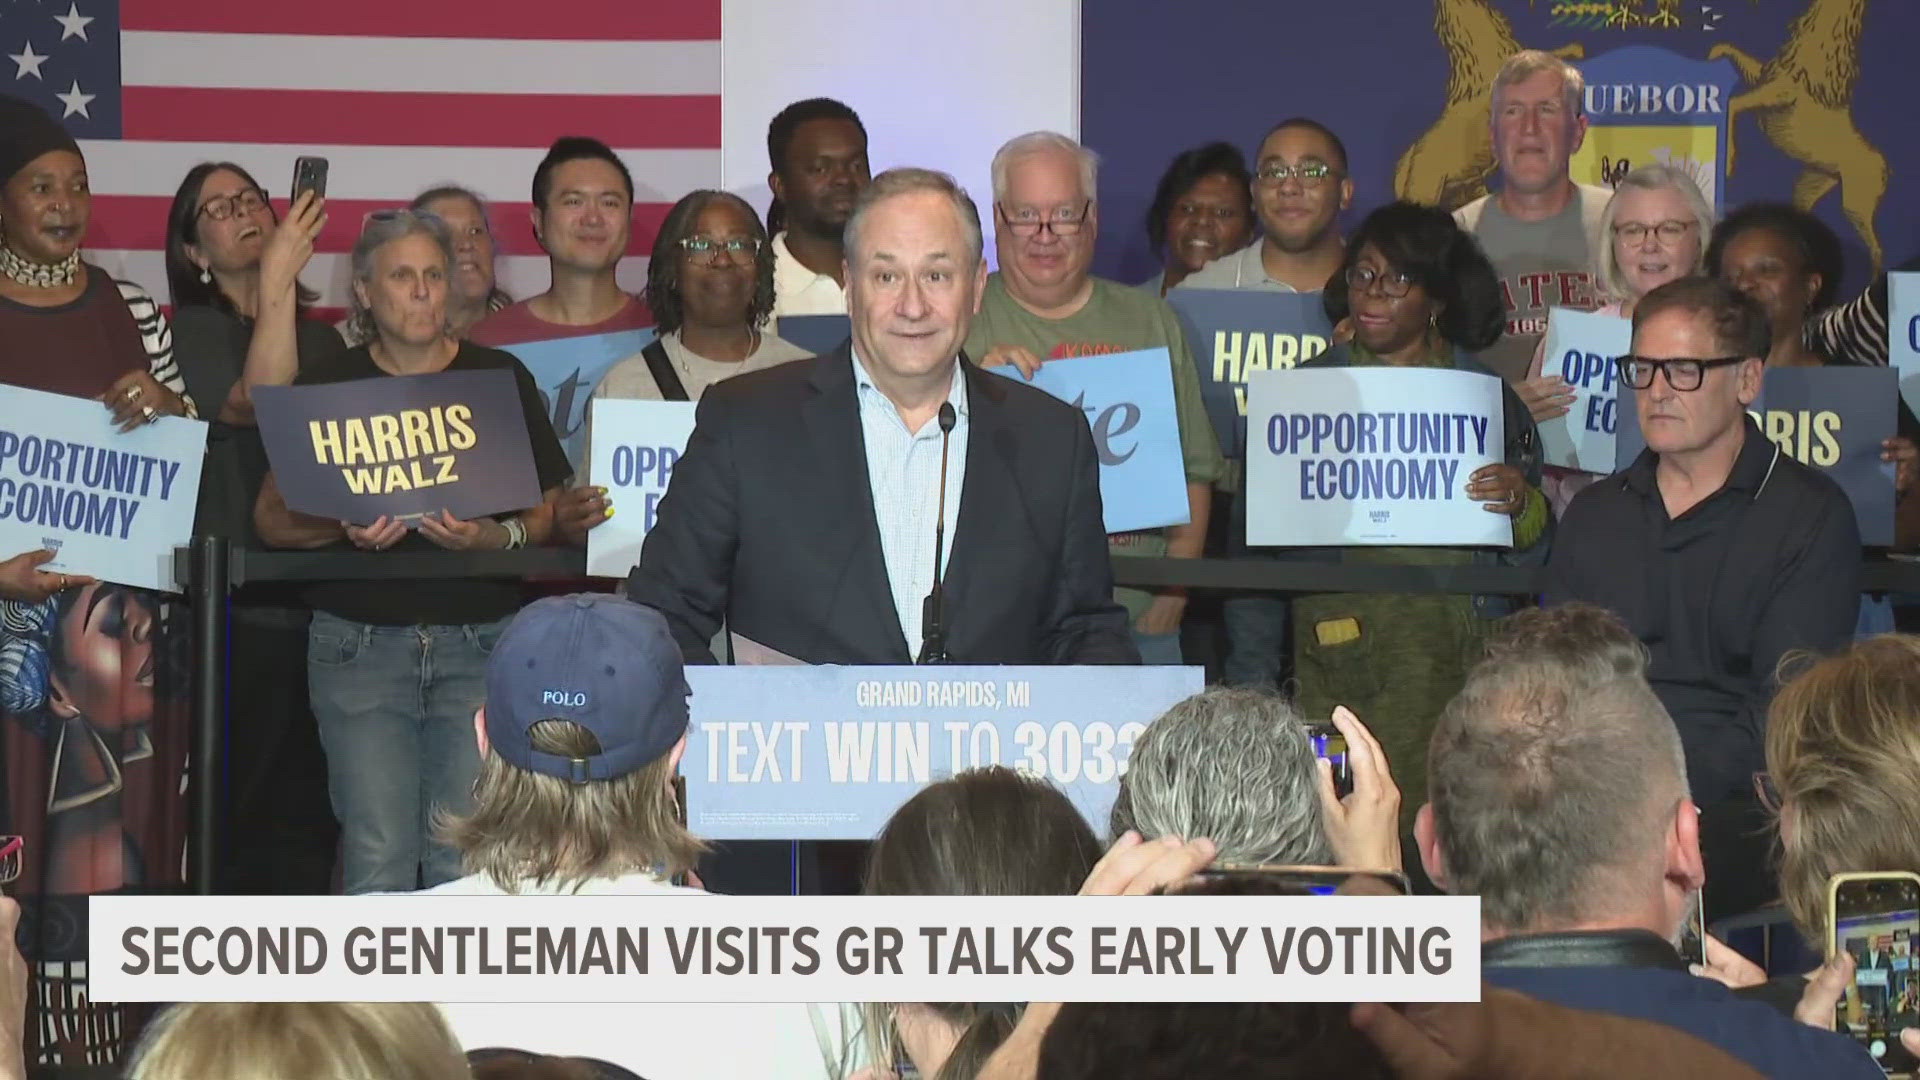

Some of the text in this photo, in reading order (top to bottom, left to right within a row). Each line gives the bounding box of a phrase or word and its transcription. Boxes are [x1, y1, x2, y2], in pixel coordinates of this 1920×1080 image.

[309, 404, 477, 465] HARRIS
[1267, 413, 1488, 456] OPPORTUNITY
[1746, 410, 1842, 467] RIS
[341, 455, 459, 494] WALZ
[1300, 458, 1459, 501] ECONOMY
[543, 690, 586, 707] POLO
[856, 680, 1030, 710] GRAND RAPIDS, MI
[701, 722, 810, 783] TEXT
[824, 722, 930, 783] WIN
[944, 721, 1000, 779] TO
